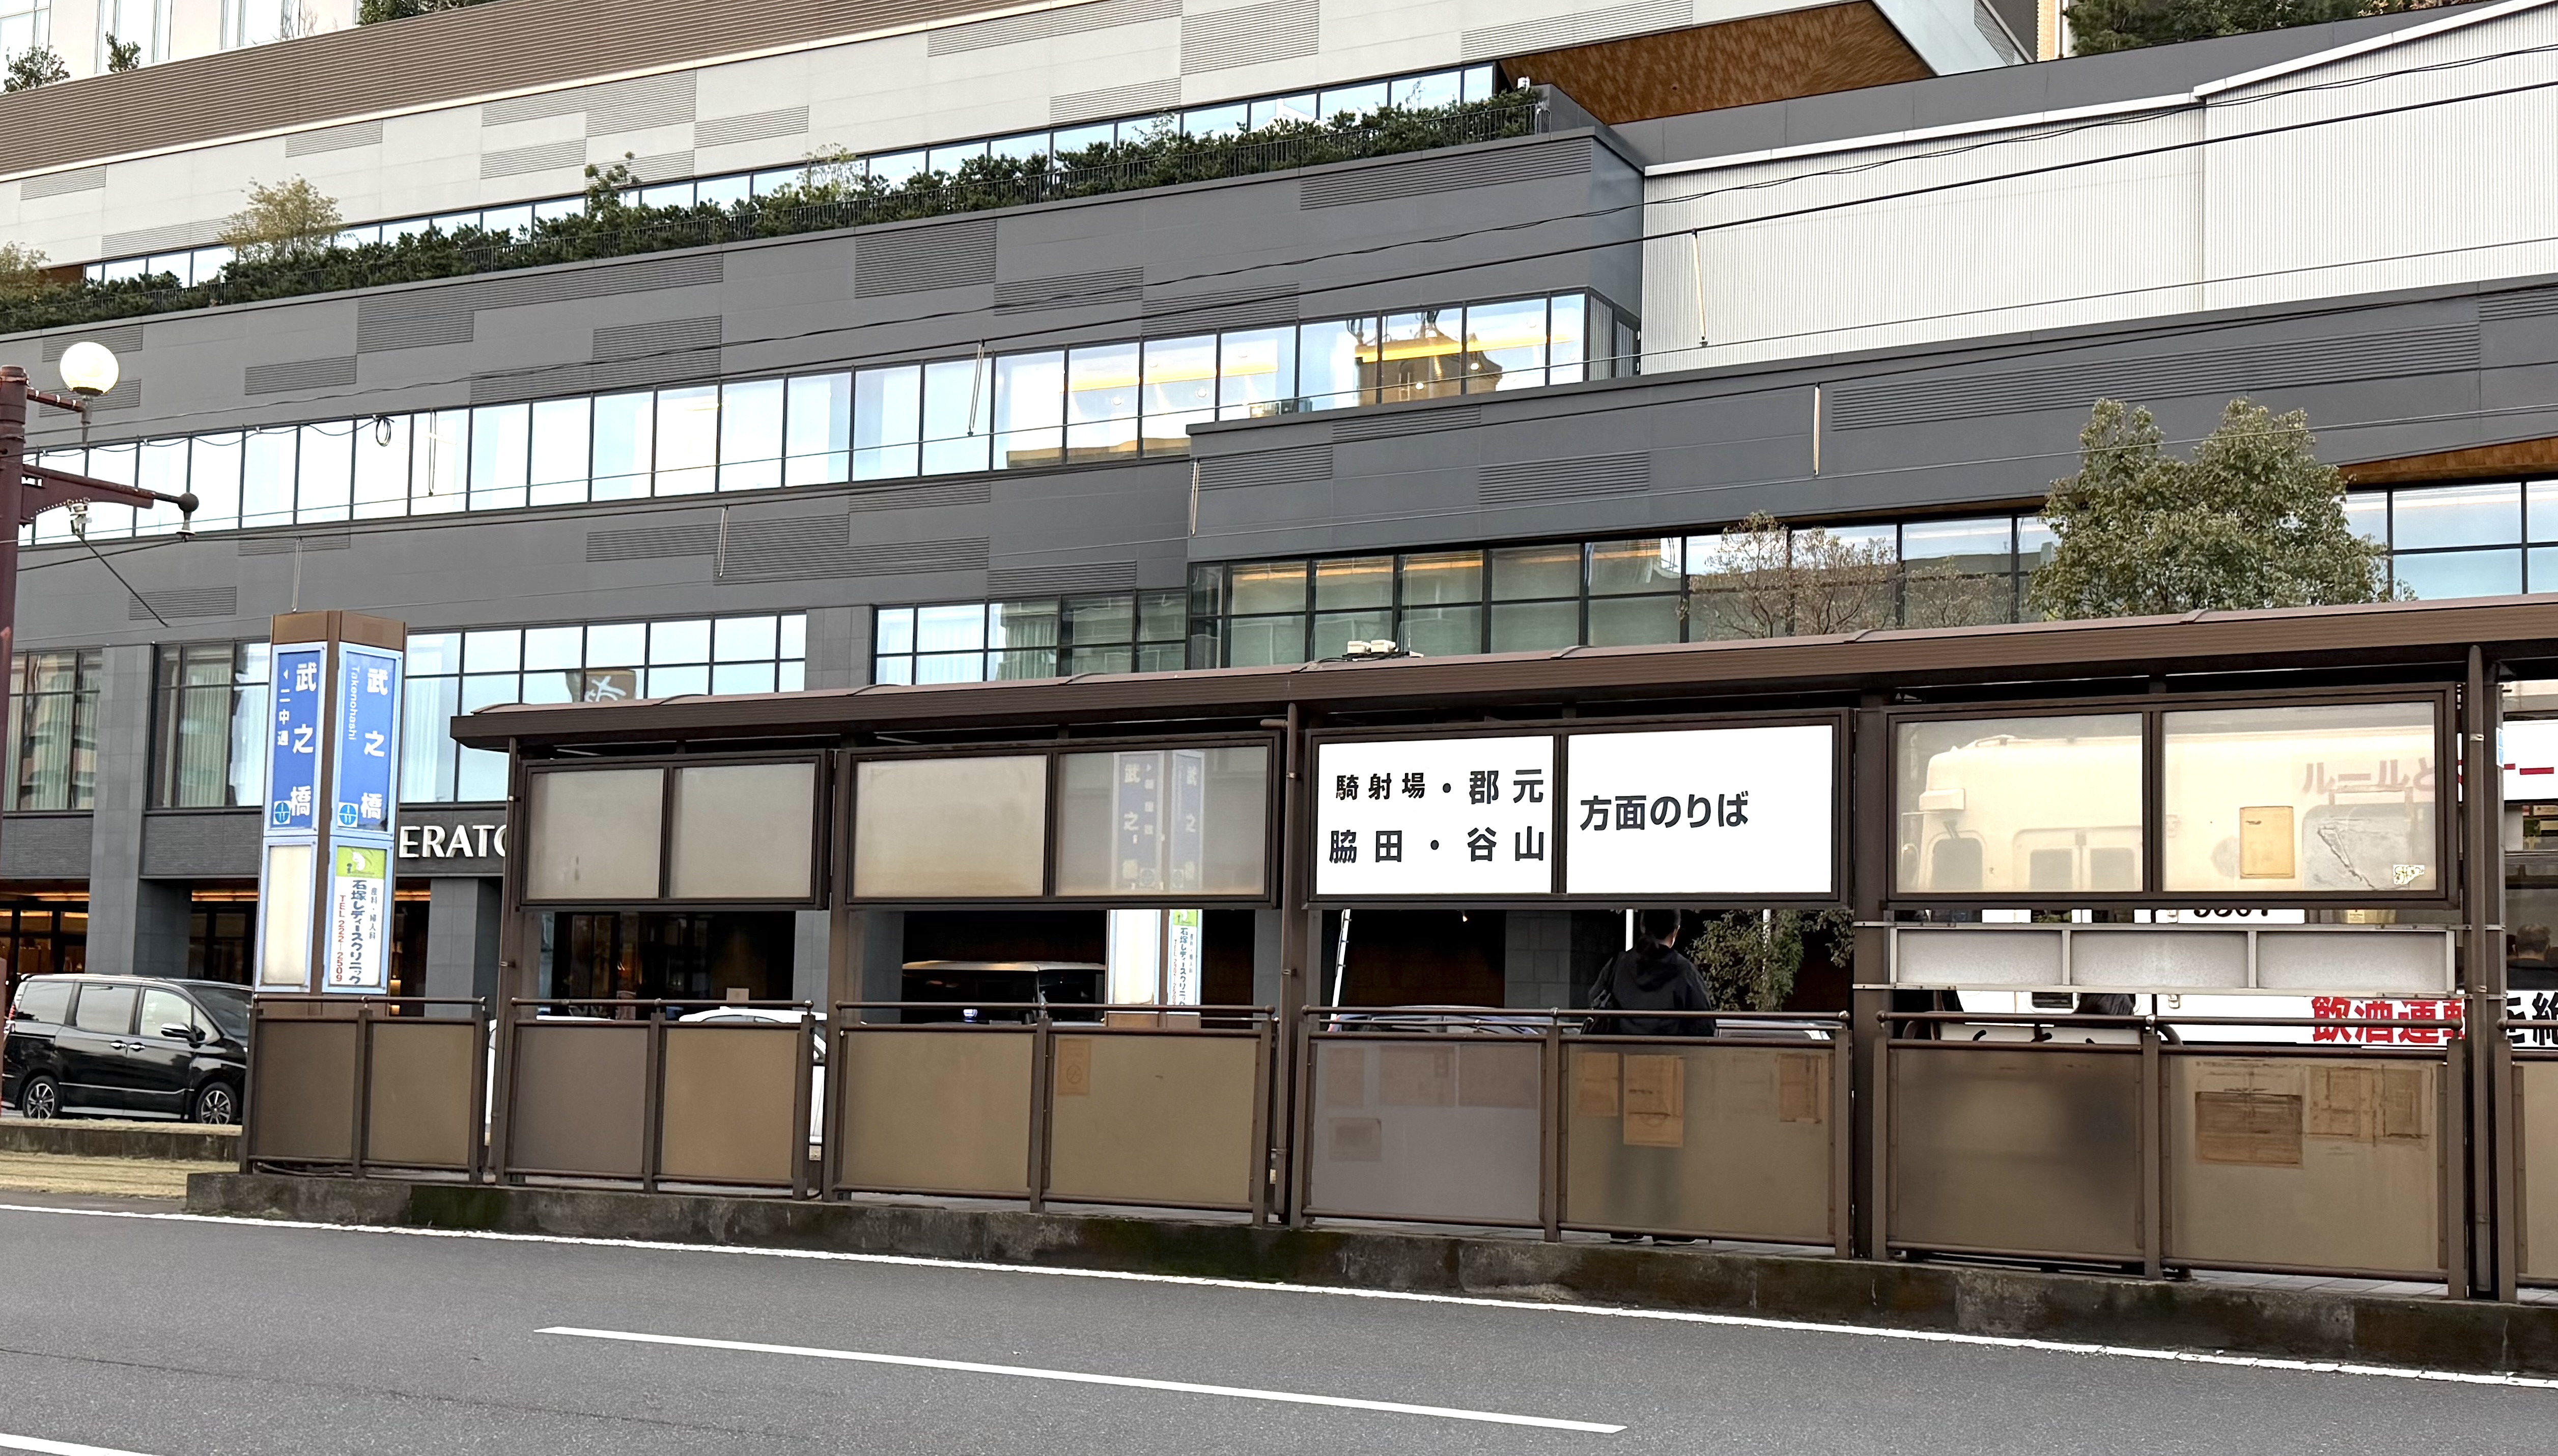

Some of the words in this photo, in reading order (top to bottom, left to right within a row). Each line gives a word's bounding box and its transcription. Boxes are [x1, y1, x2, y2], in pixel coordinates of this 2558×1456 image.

[277, 689, 291, 746] 二中通
[290, 662, 317, 816] 武之橋
[360, 667, 388, 819] 武之橋
[1335, 768, 1544, 805] 騎射場・郡元
[1580, 790, 1749, 831] 方面のりば
[1329, 825, 1544, 864] 脇田・谷山
[349, 880, 367, 984] 石塚レディースクリニック
